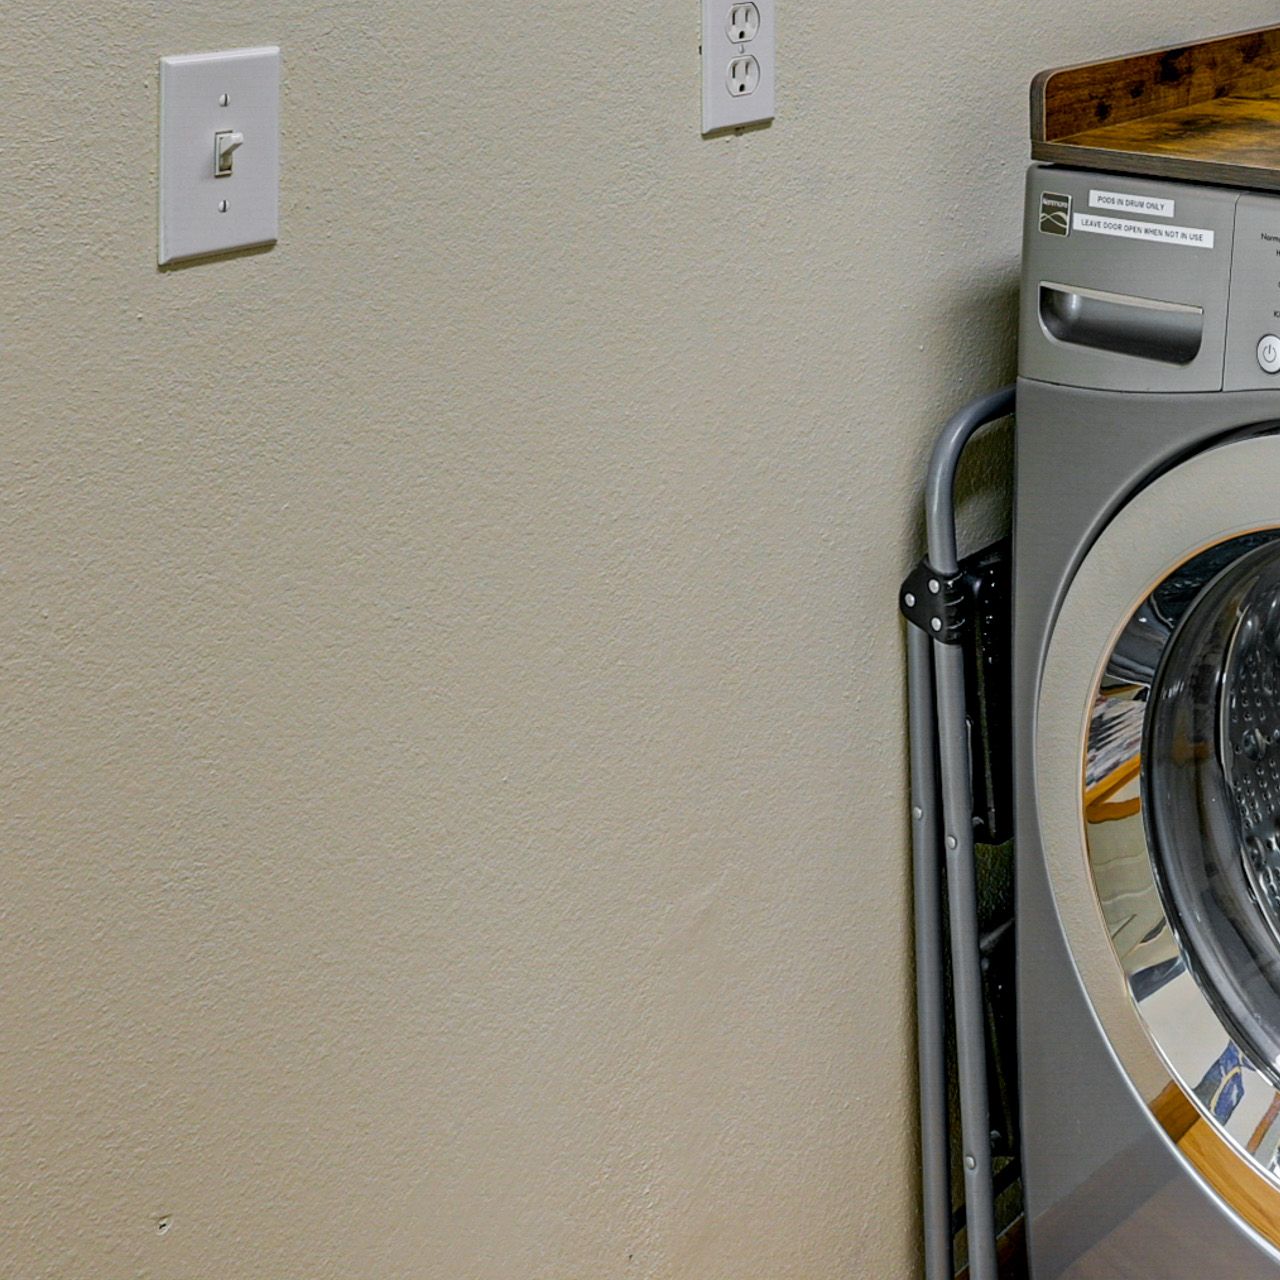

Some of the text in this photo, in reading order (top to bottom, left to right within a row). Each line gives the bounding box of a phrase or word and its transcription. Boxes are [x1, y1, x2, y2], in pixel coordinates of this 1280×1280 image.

[1097, 196, 1115, 205] PODS
[1125, 199, 1144, 208] DRUM
[1146, 201, 1164, 211] ONLY
[1081, 219, 1203, 242] LEAVE DOOR OPEN WHEN NOT IN USE
